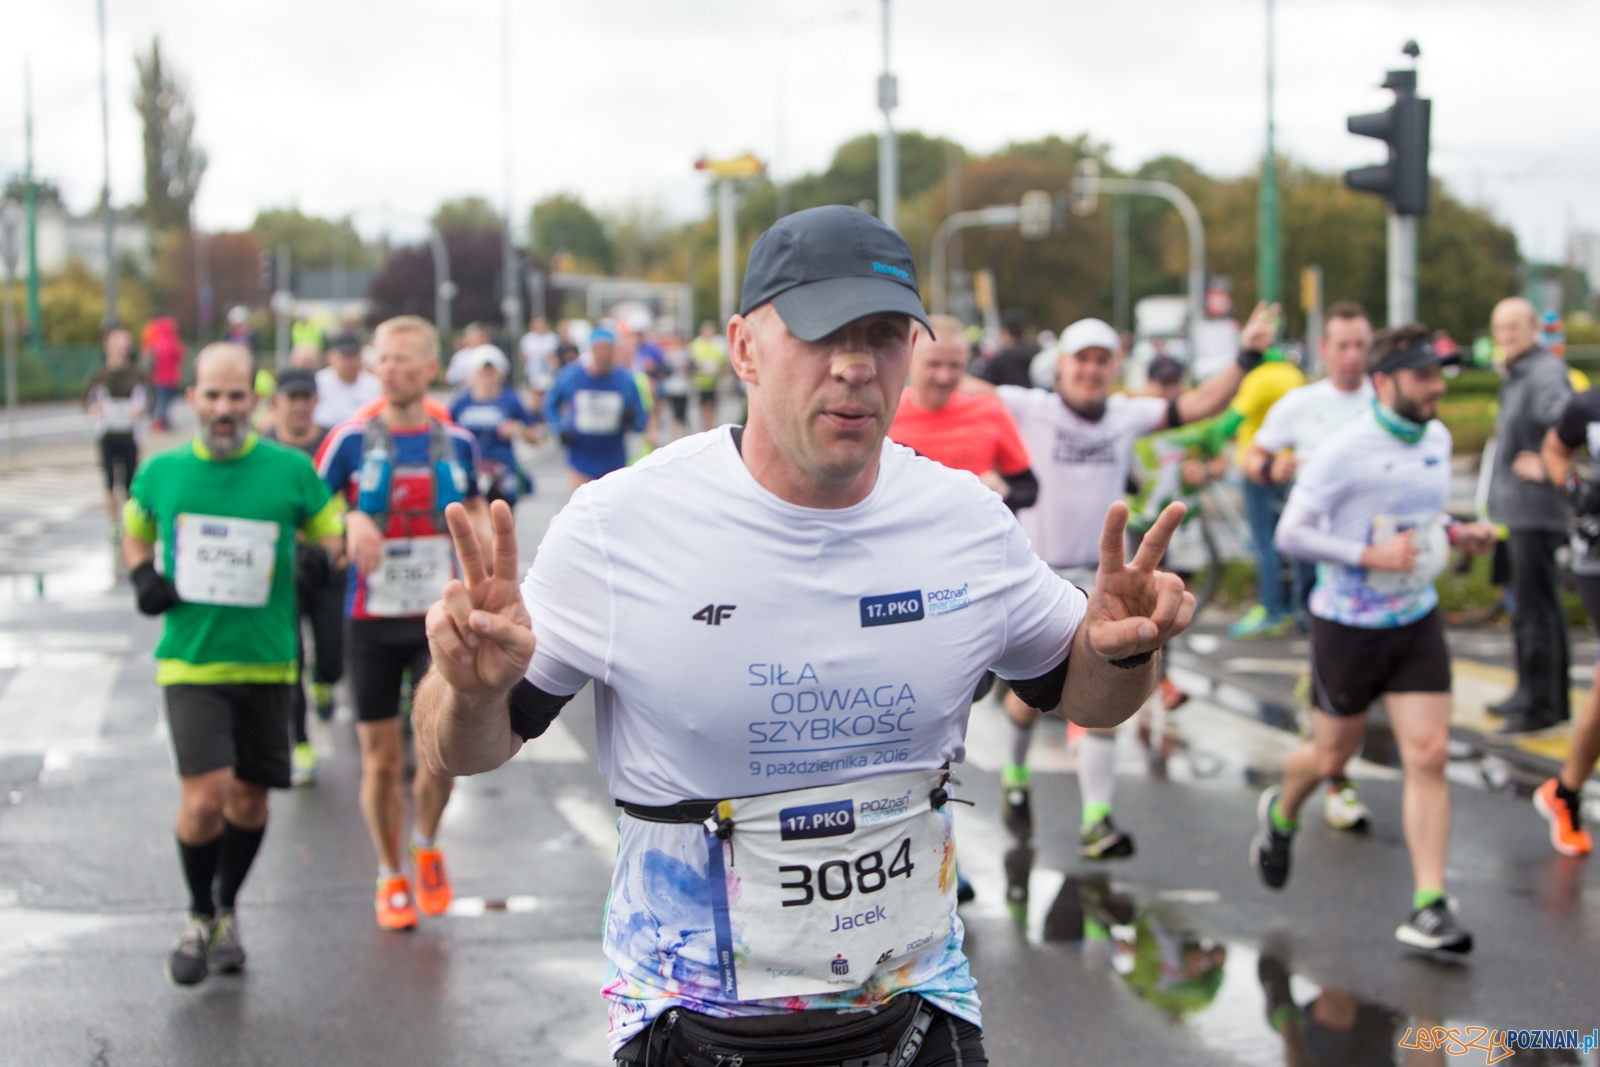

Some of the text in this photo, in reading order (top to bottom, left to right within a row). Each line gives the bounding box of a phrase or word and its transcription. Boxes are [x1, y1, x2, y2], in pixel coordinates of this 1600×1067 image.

[692, 604, 737, 625] 4F
[748, 662, 820, 686] SIŁA
[771, 683, 916, 714] ODWAGA
[748, 707, 916, 744] SZYBKOŚĆ
[750, 748, 909, 778] 9 października 2016
[778, 837, 915, 907] 3084
[830, 905, 887, 932] Jacek
